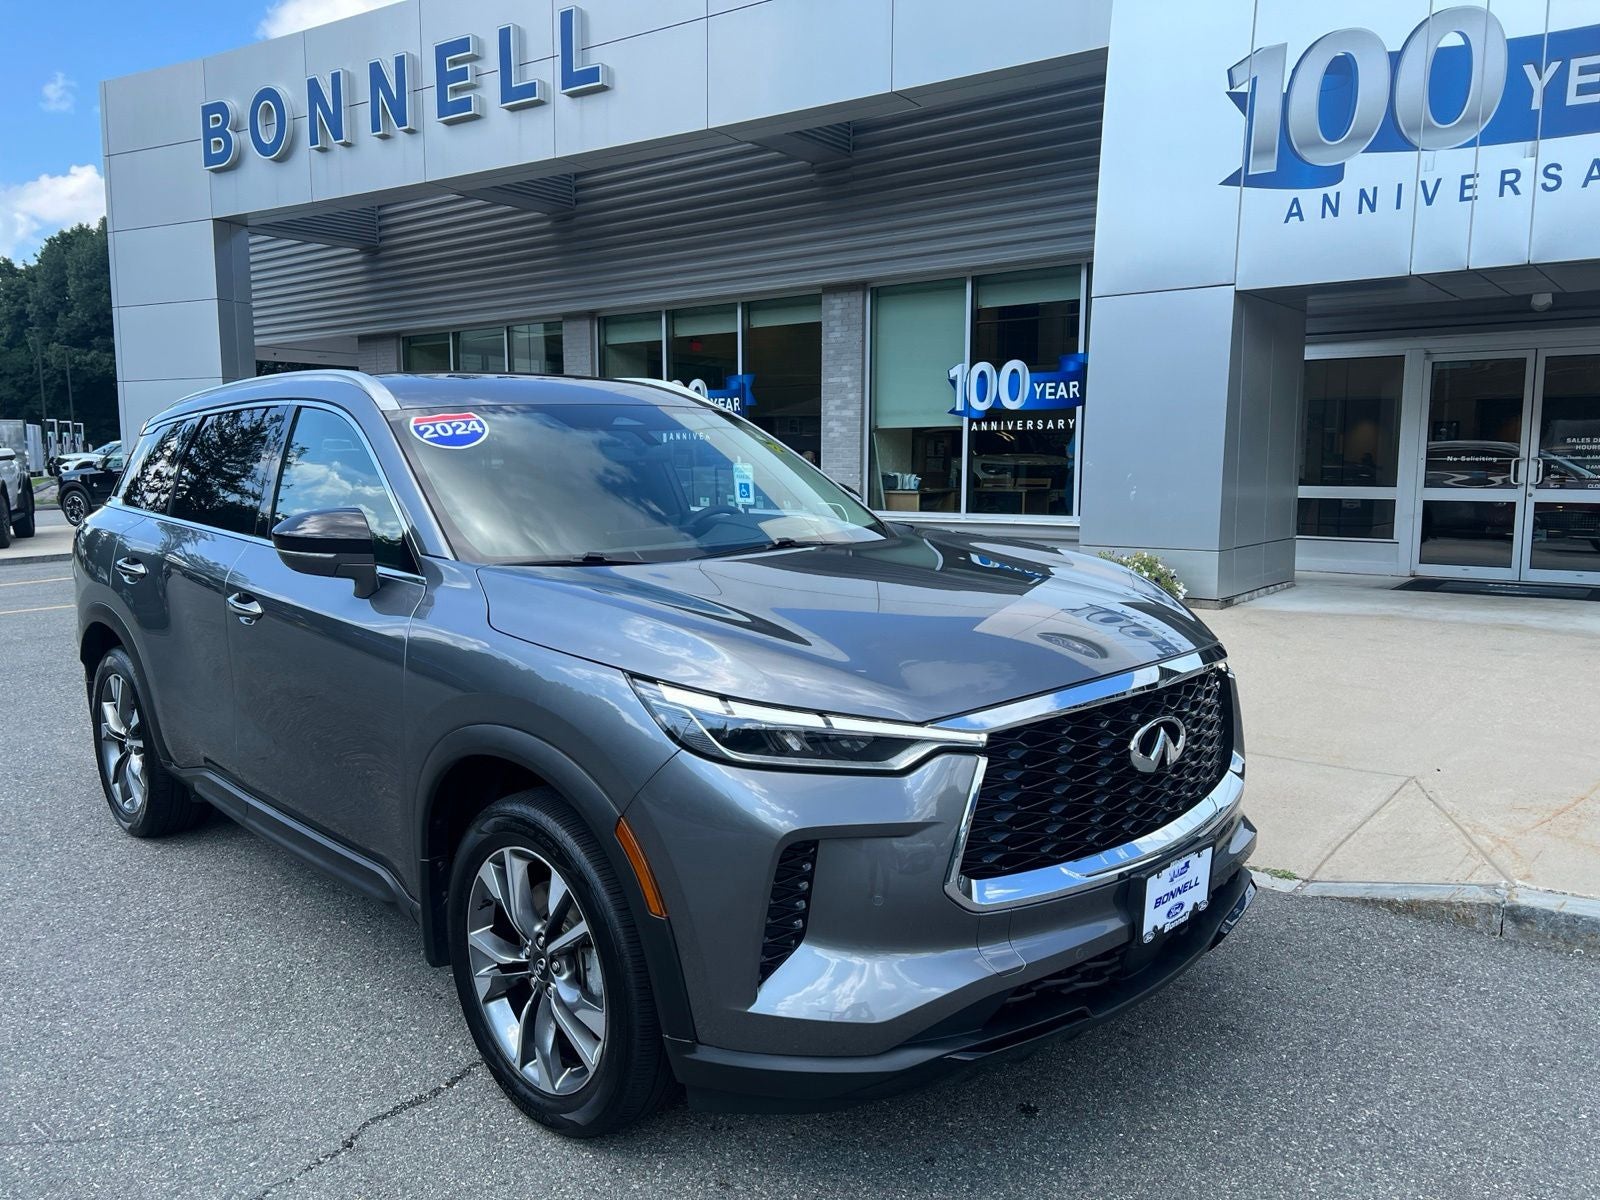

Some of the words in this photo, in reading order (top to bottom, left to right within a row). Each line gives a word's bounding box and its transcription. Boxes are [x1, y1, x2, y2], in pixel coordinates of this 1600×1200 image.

[200, 5, 608, 172] BONNELL
[1227, 5, 1508, 175] 100
[1522, 54, 1600, 111] YE
[1284, 157, 1600, 224] ANNIVERSA
[948, 359, 1031, 411] 100
[1034, 381, 1080, 399] YEAR
[419, 420, 484, 439] 2024
[971, 418, 1075, 431] ANNIVERSARY
[1153, 876, 1200, 910] BONNELL
